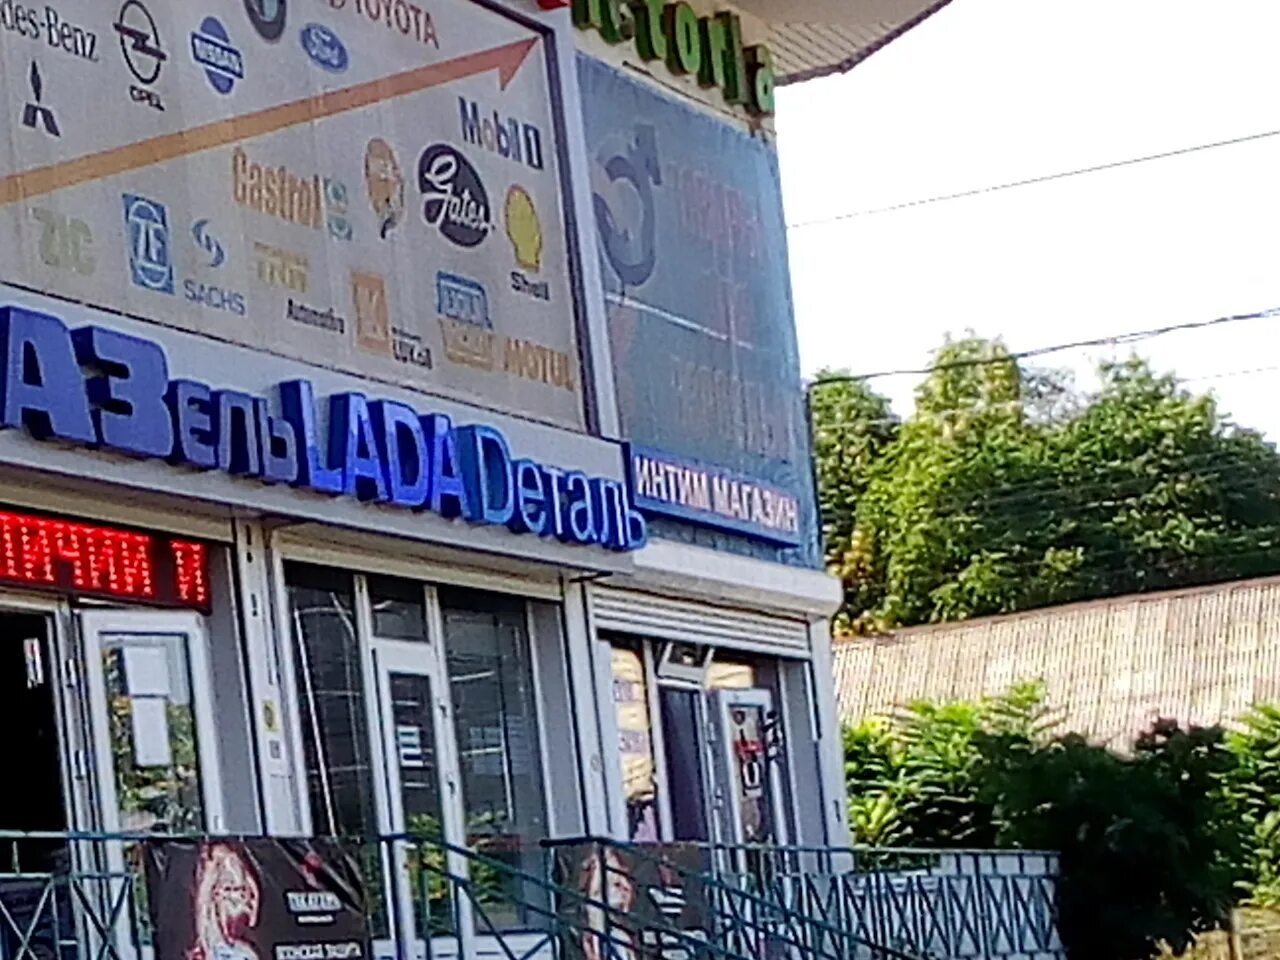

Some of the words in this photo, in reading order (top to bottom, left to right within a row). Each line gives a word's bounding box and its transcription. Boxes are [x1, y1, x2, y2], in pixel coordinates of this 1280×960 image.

[232, 147, 325, 229] Castrol
[183, 279, 246, 317] SACHS
[634, 455, 711, 513] ИНТИМ
[712, 473, 800, 533] МАГАЗИН
